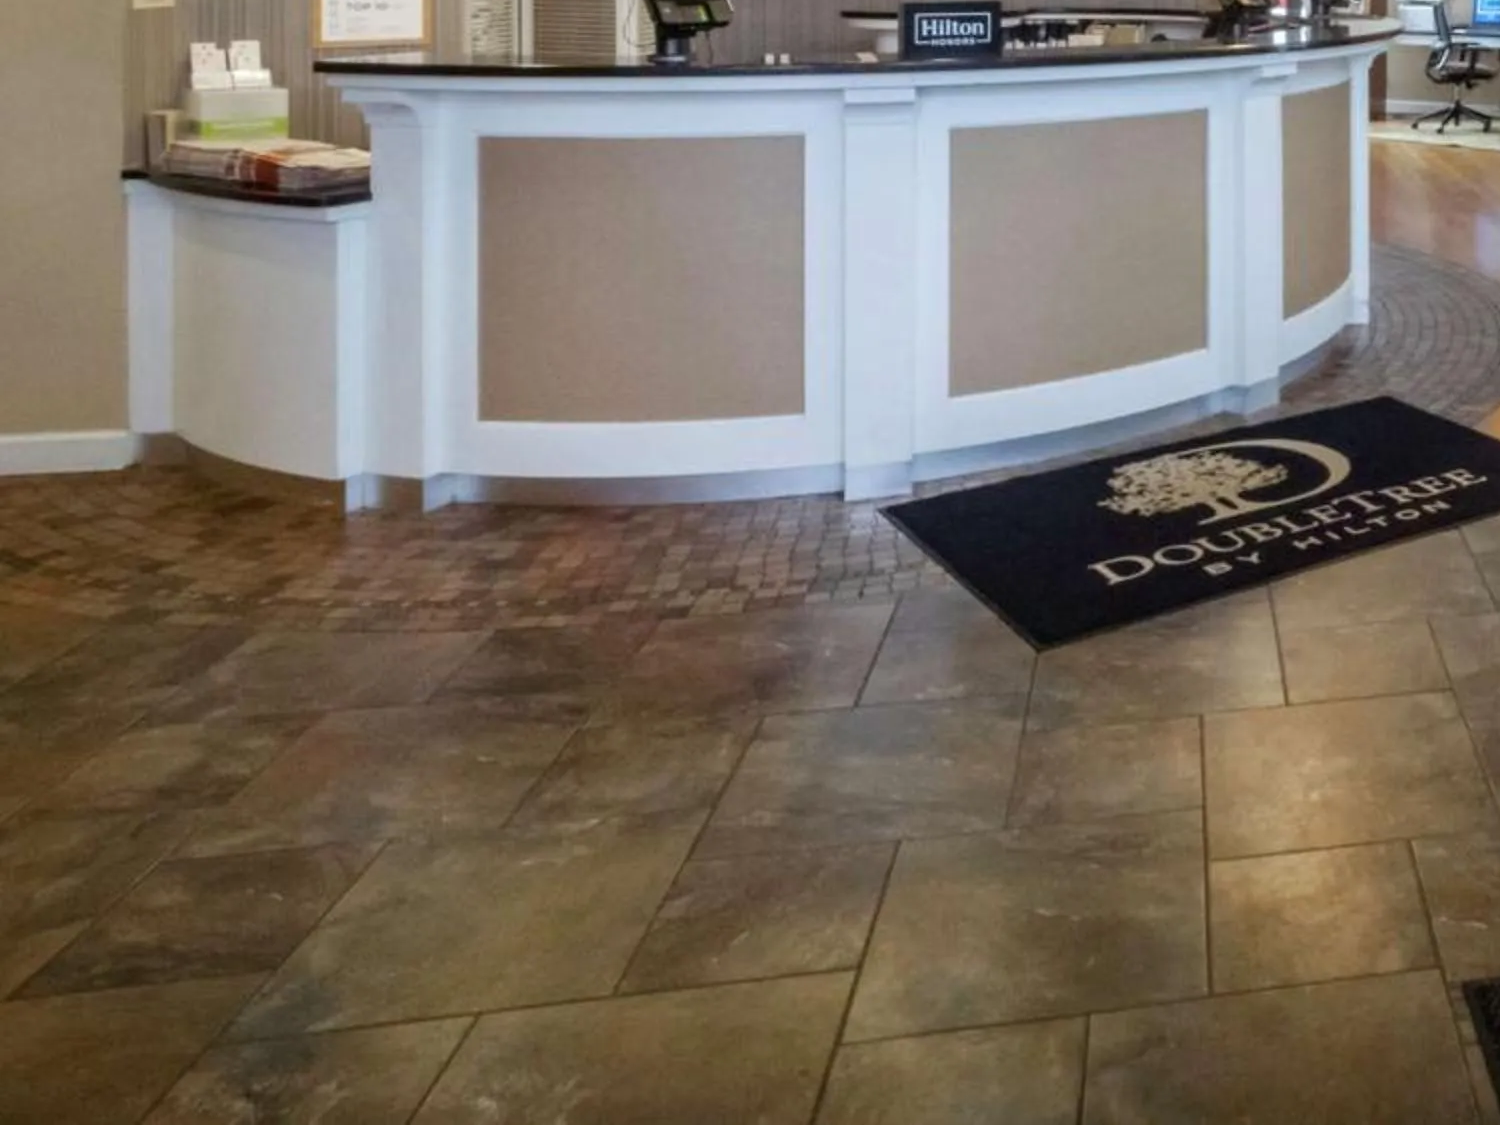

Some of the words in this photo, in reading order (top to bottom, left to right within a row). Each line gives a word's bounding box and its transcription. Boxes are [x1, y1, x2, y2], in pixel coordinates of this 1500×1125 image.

[922, 18, 984, 36] Hilton
[1204, 552, 1263, 576] BY
[1293, 500, 1451, 551] HILTON
